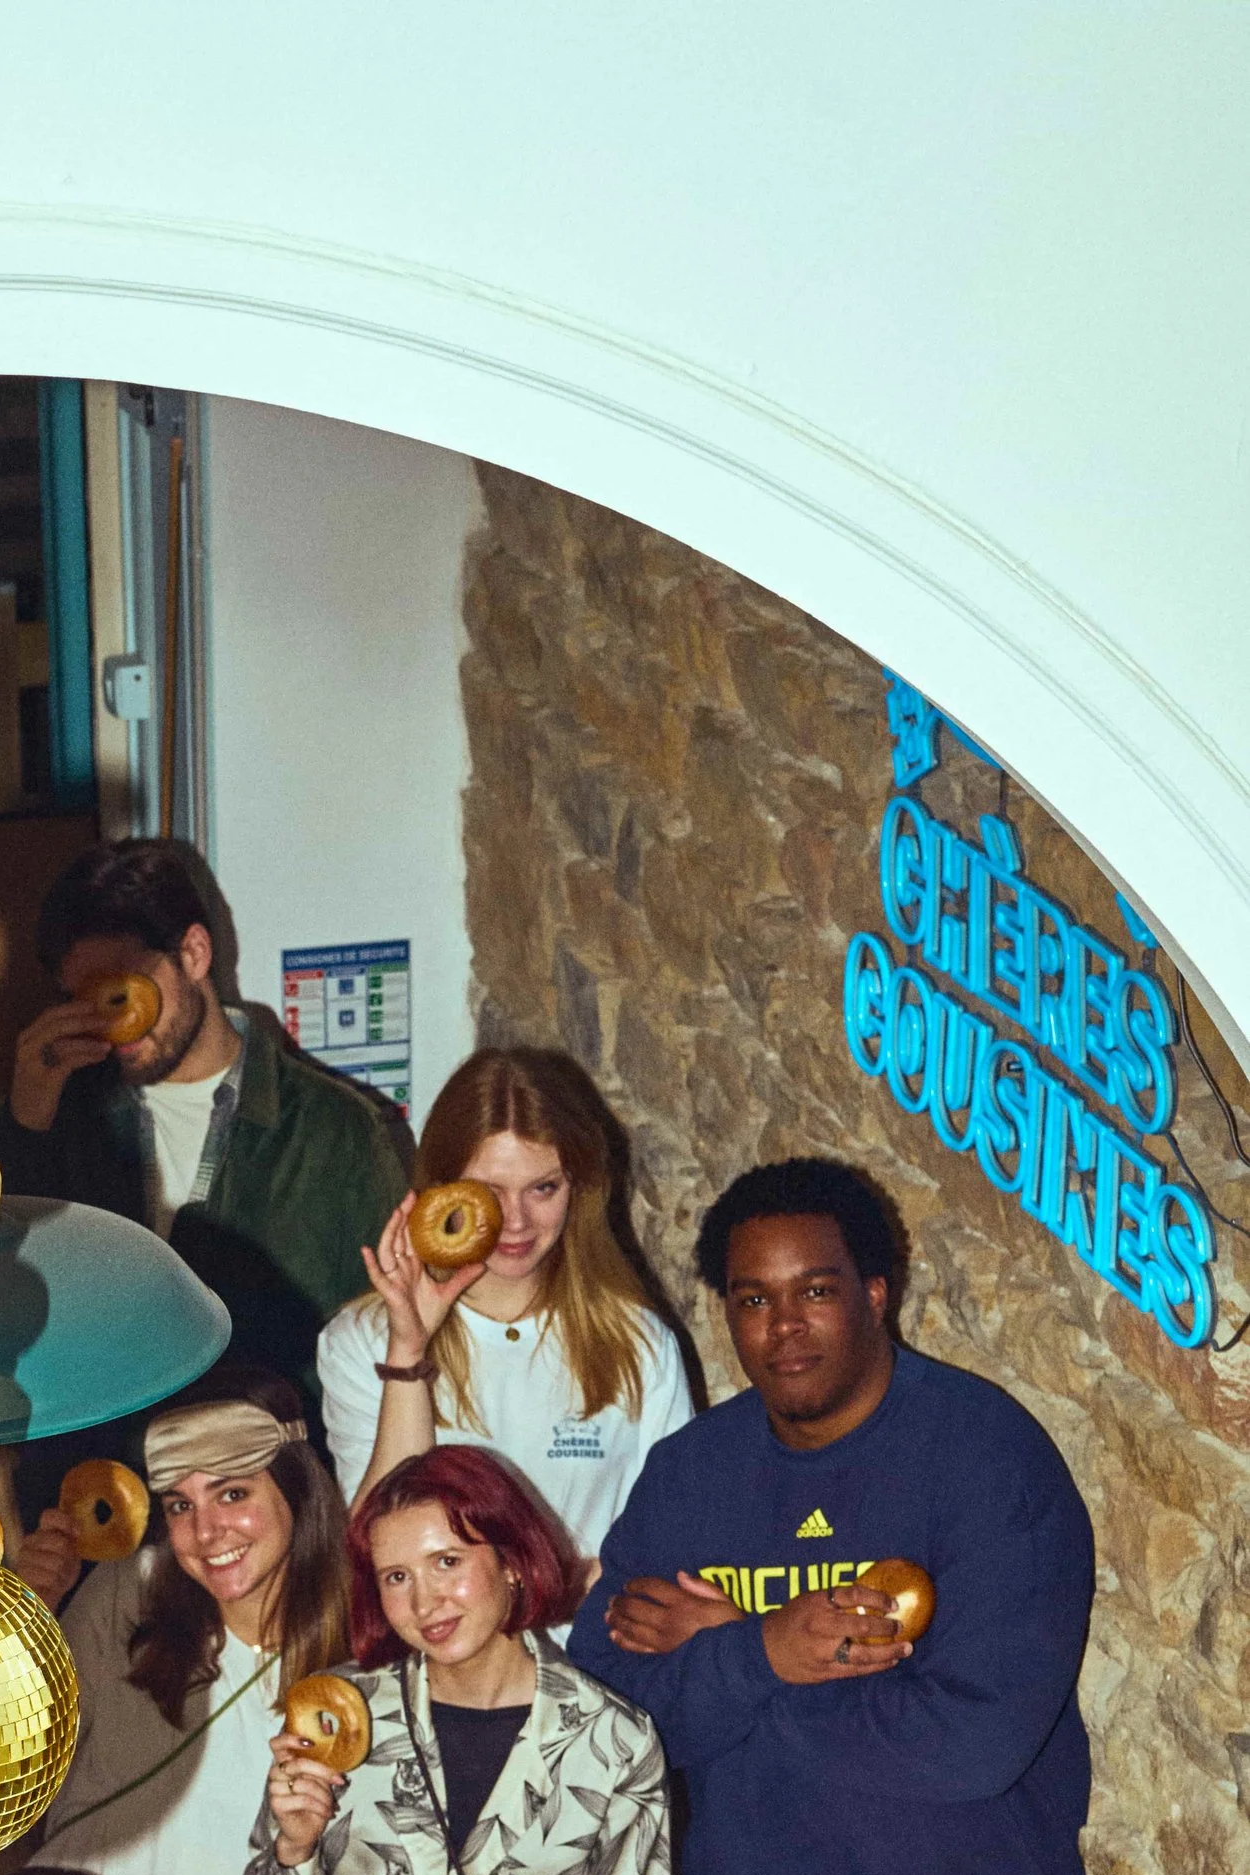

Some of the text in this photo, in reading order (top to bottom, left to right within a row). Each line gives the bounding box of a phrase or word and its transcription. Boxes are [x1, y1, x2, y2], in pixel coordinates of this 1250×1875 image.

[880, 797, 1178, 1134] CHÈRES
[844, 932, 1214, 1348] COUSINES
[553, 1437, 600, 1448] CHÈRES
[547, 1449, 605, 1459] COUSINES
[796, 1526, 834, 1538] adidas
